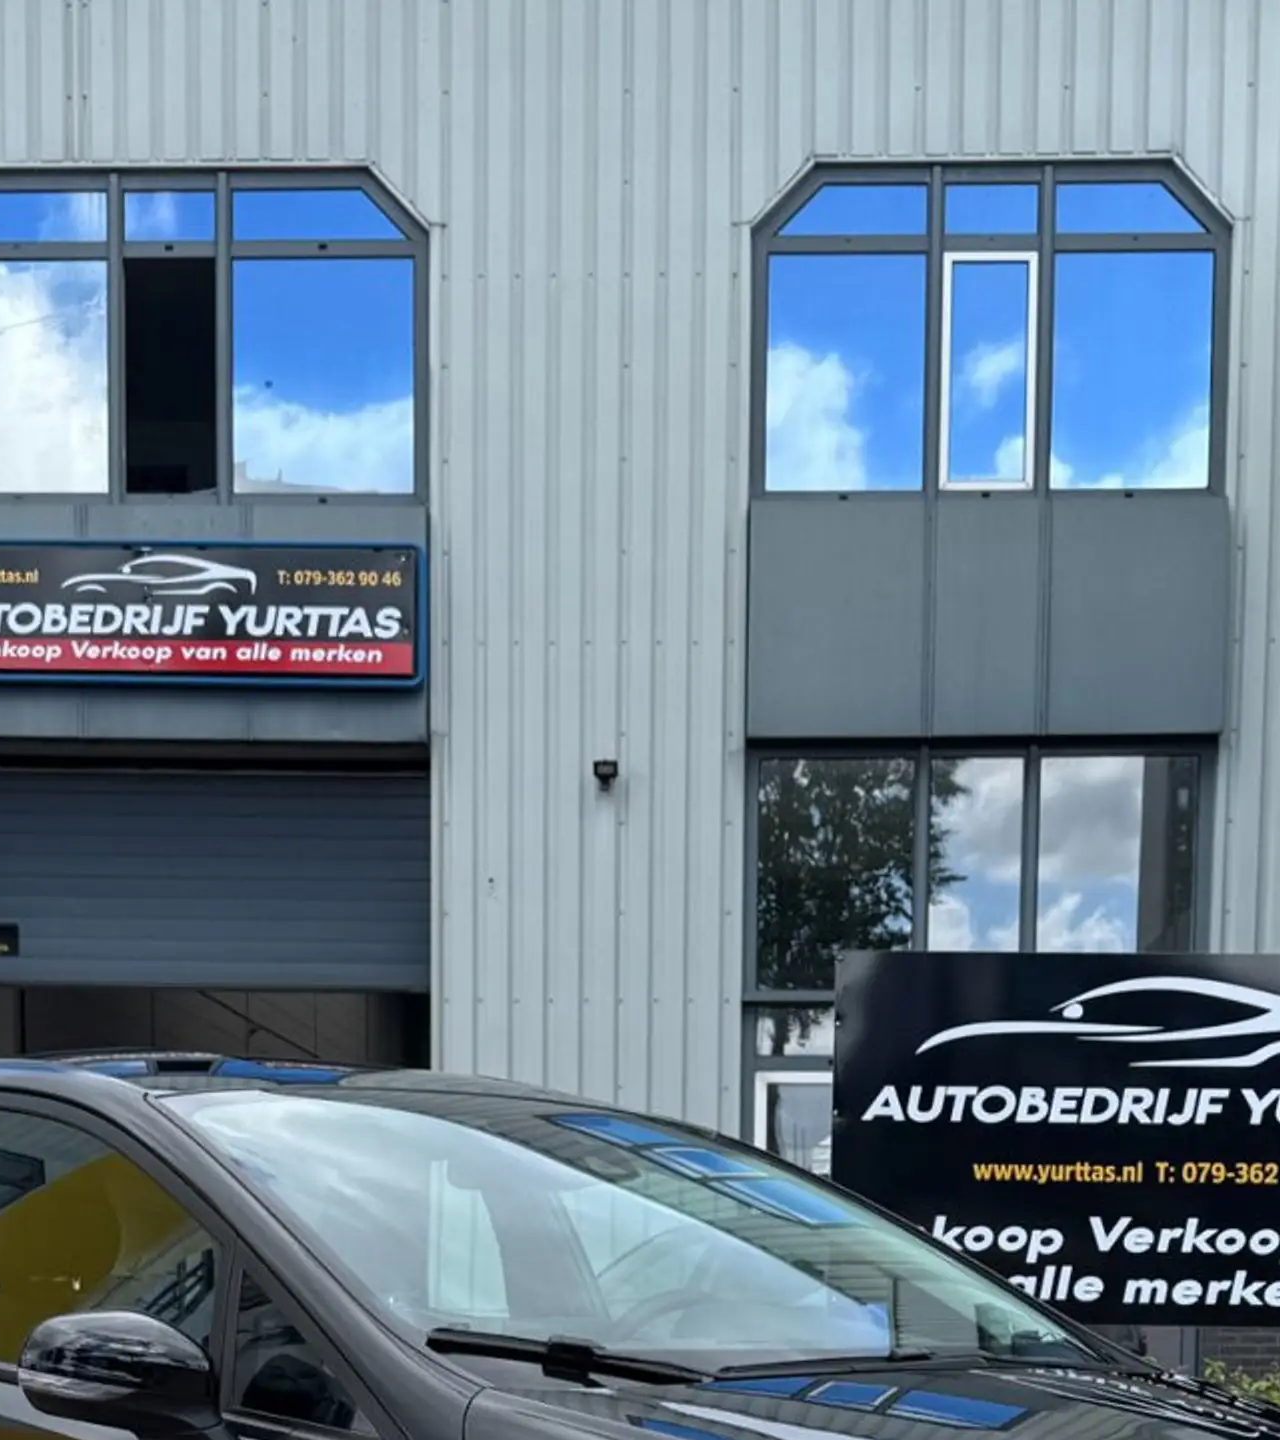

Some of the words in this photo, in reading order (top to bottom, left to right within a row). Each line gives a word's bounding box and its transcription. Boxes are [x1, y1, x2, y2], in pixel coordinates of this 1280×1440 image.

[277, 569, 291, 586] T:
[293, 570, 355, 587] 079-362
[359, 571, 382, 587] 90
[385, 571, 401, 587] 46
[218, 605, 401, 638] YURTTAS
[72, 641, 172, 663] Verkoop
[181, 646, 227, 660] van
[236, 643, 282, 661] alle
[290, 644, 383, 662] merken
[861, 1085, 1230, 1125] AUTOBEDRIJF
[973, 1161, 1144, 1185] www.yurttas.nl
[1155, 1162, 1176, 1183] T:
[1182, 1162, 1279, 1185] 079-362
[923, 1215, 1064, 1264] koop
[1008, 1265, 1105, 1302] alle
